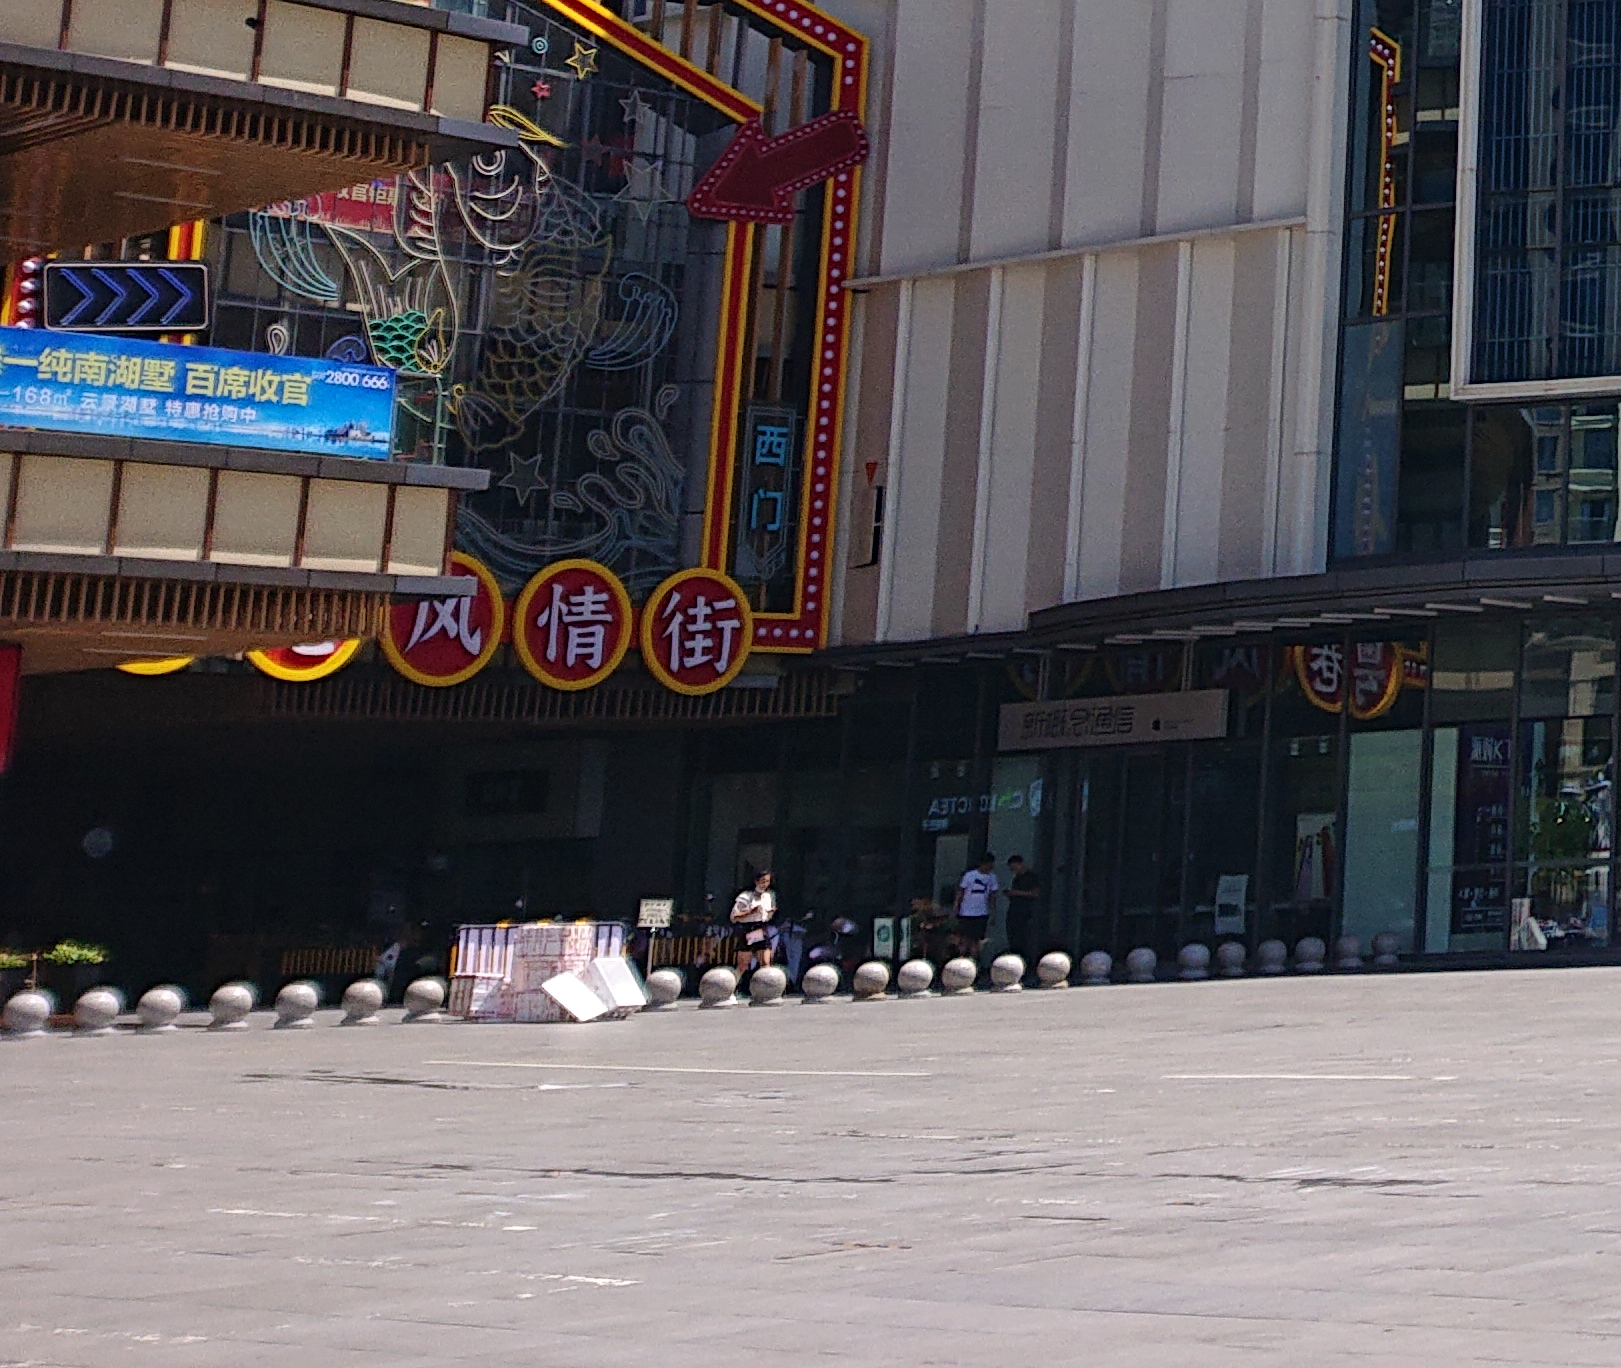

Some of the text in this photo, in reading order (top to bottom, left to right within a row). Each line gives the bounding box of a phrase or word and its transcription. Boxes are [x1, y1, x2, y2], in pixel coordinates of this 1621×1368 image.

[0, 343, 312, 407] 一纯南湖墅 百席收官
[326, 369, 360, 387] 2800
[361, 375, 388, 390] 666
[751, 425, 789, 530] 西门
